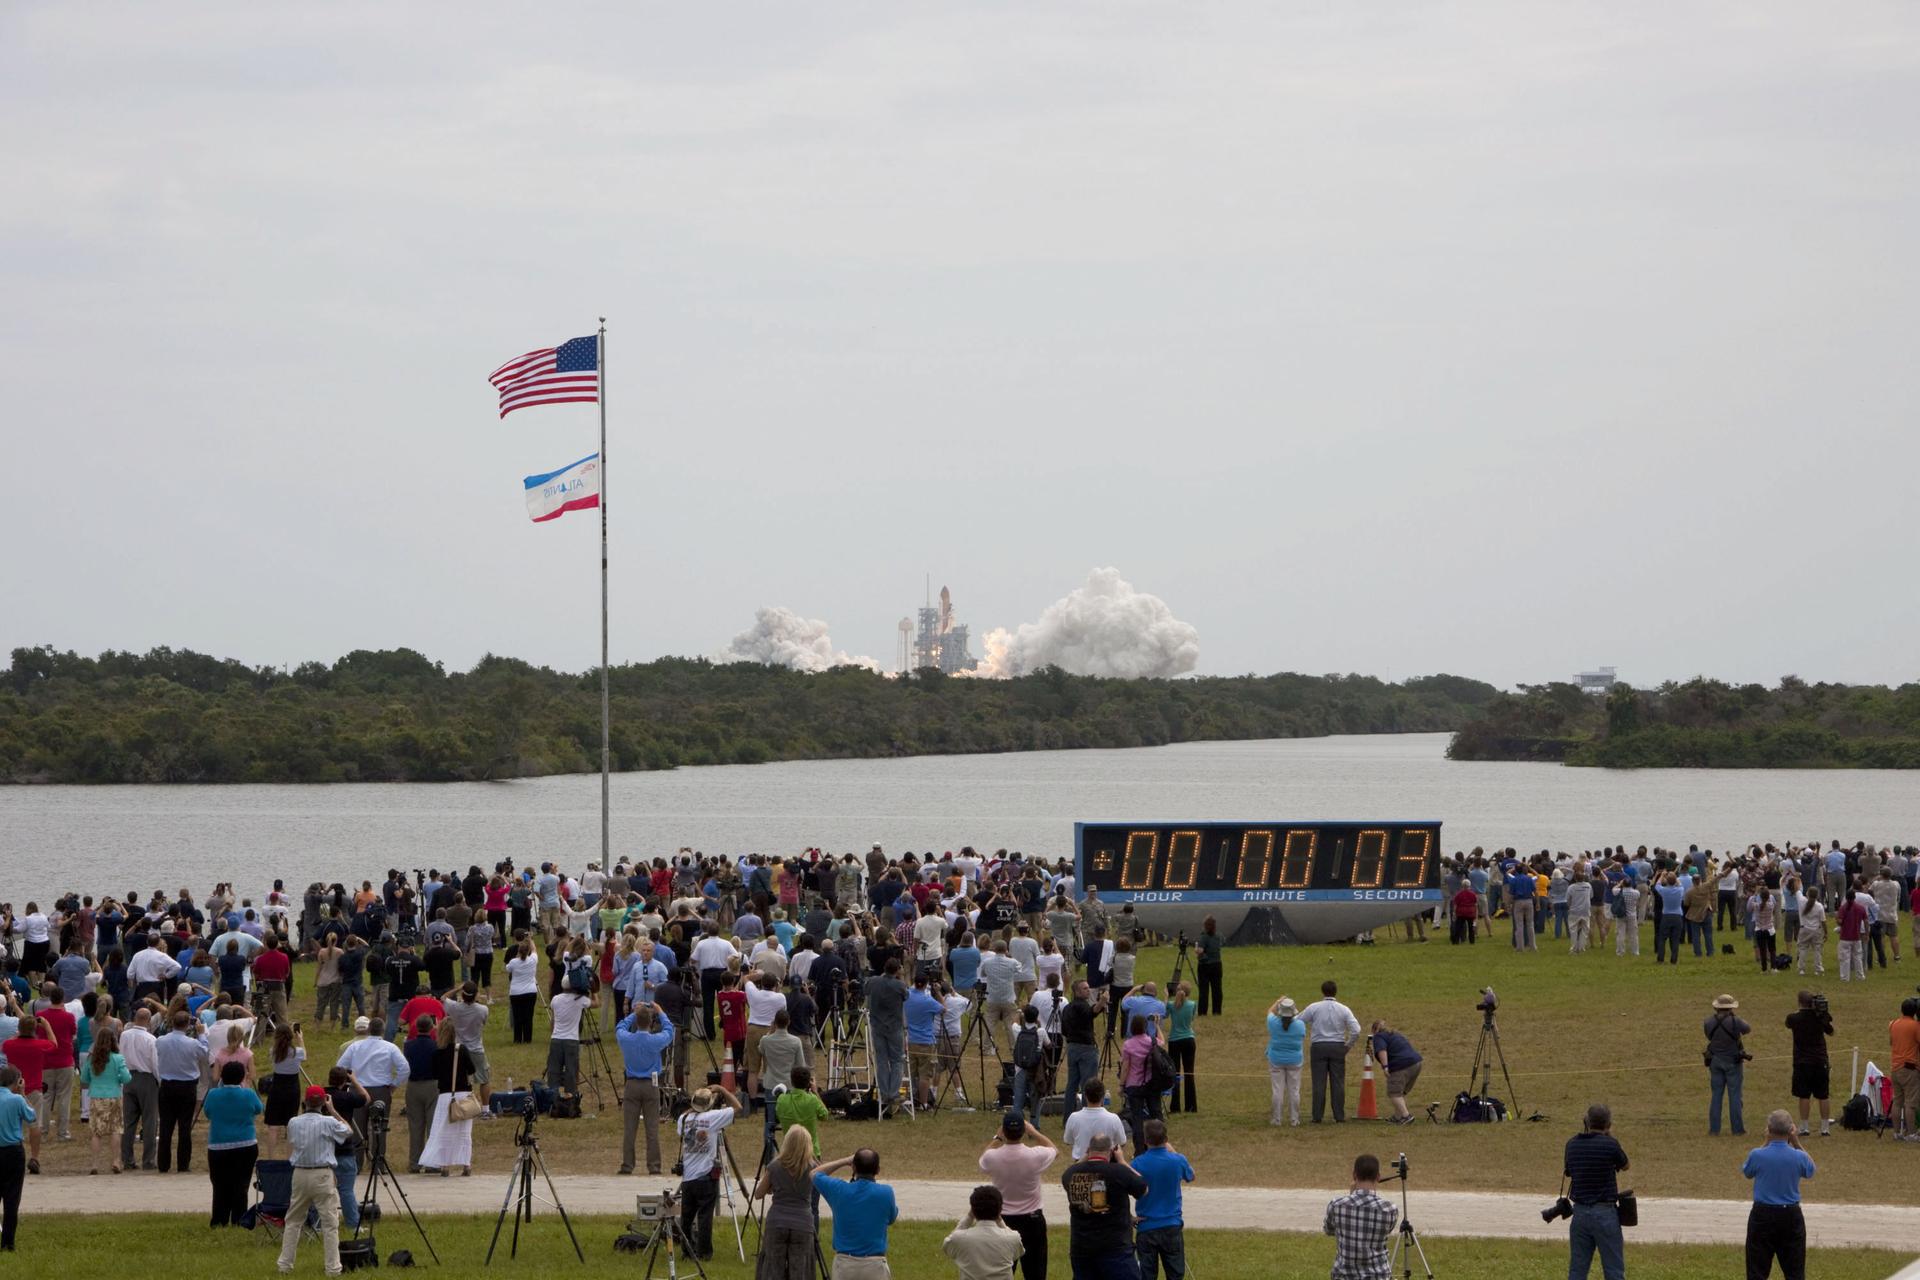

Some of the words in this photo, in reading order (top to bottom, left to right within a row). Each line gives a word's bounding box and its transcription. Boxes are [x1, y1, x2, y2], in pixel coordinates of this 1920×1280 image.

[1133, 891, 1183, 902] HOUR
[1243, 890, 1307, 901] MINUTE
[1353, 889, 1424, 900] SECOND
[997, 909, 1014, 917] TV
[722, 1000, 732, 1015] 2
[1070, 1183, 1089, 1193] THIS
